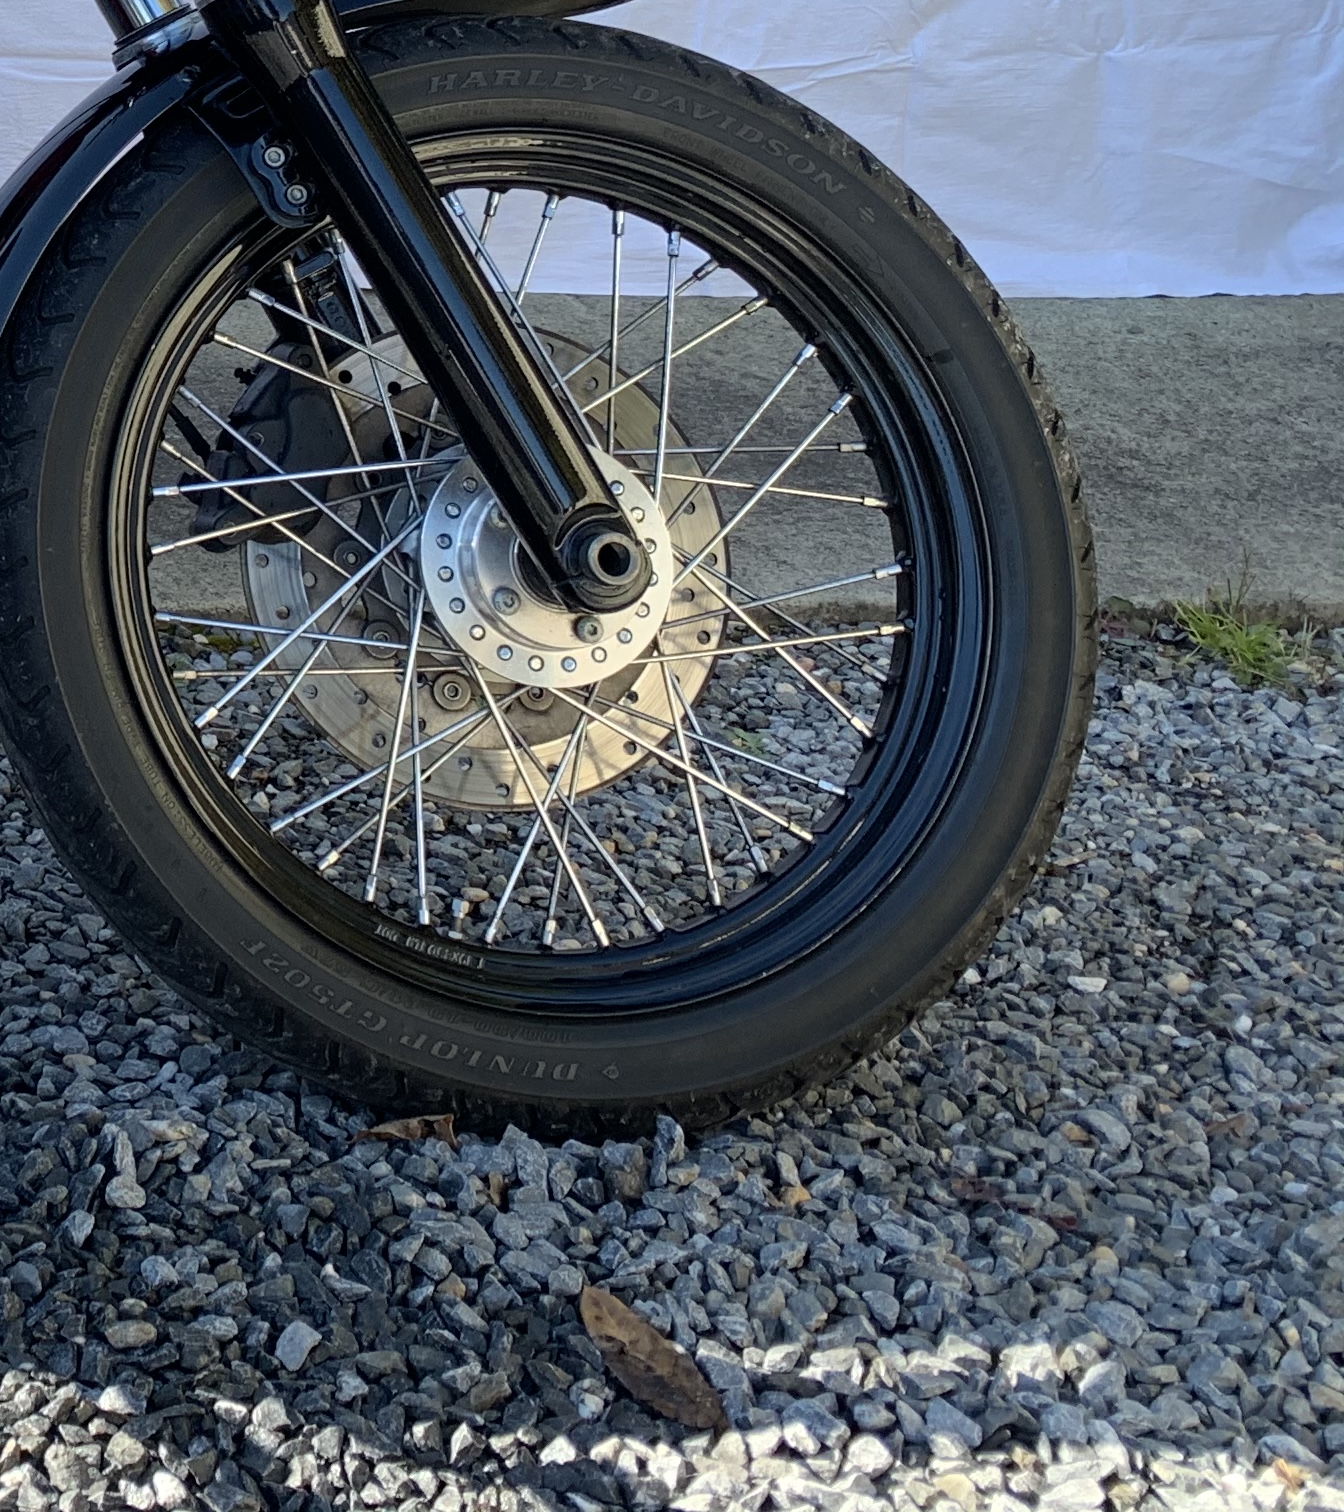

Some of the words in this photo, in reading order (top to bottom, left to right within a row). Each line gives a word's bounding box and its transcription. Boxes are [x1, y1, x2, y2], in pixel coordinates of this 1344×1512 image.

[427, 70, 847, 196] HARLEY-DAVIDSON
[240, 935, 388, 1034] GT502F
[400, 1031, 580, 1081] DUNLOP
